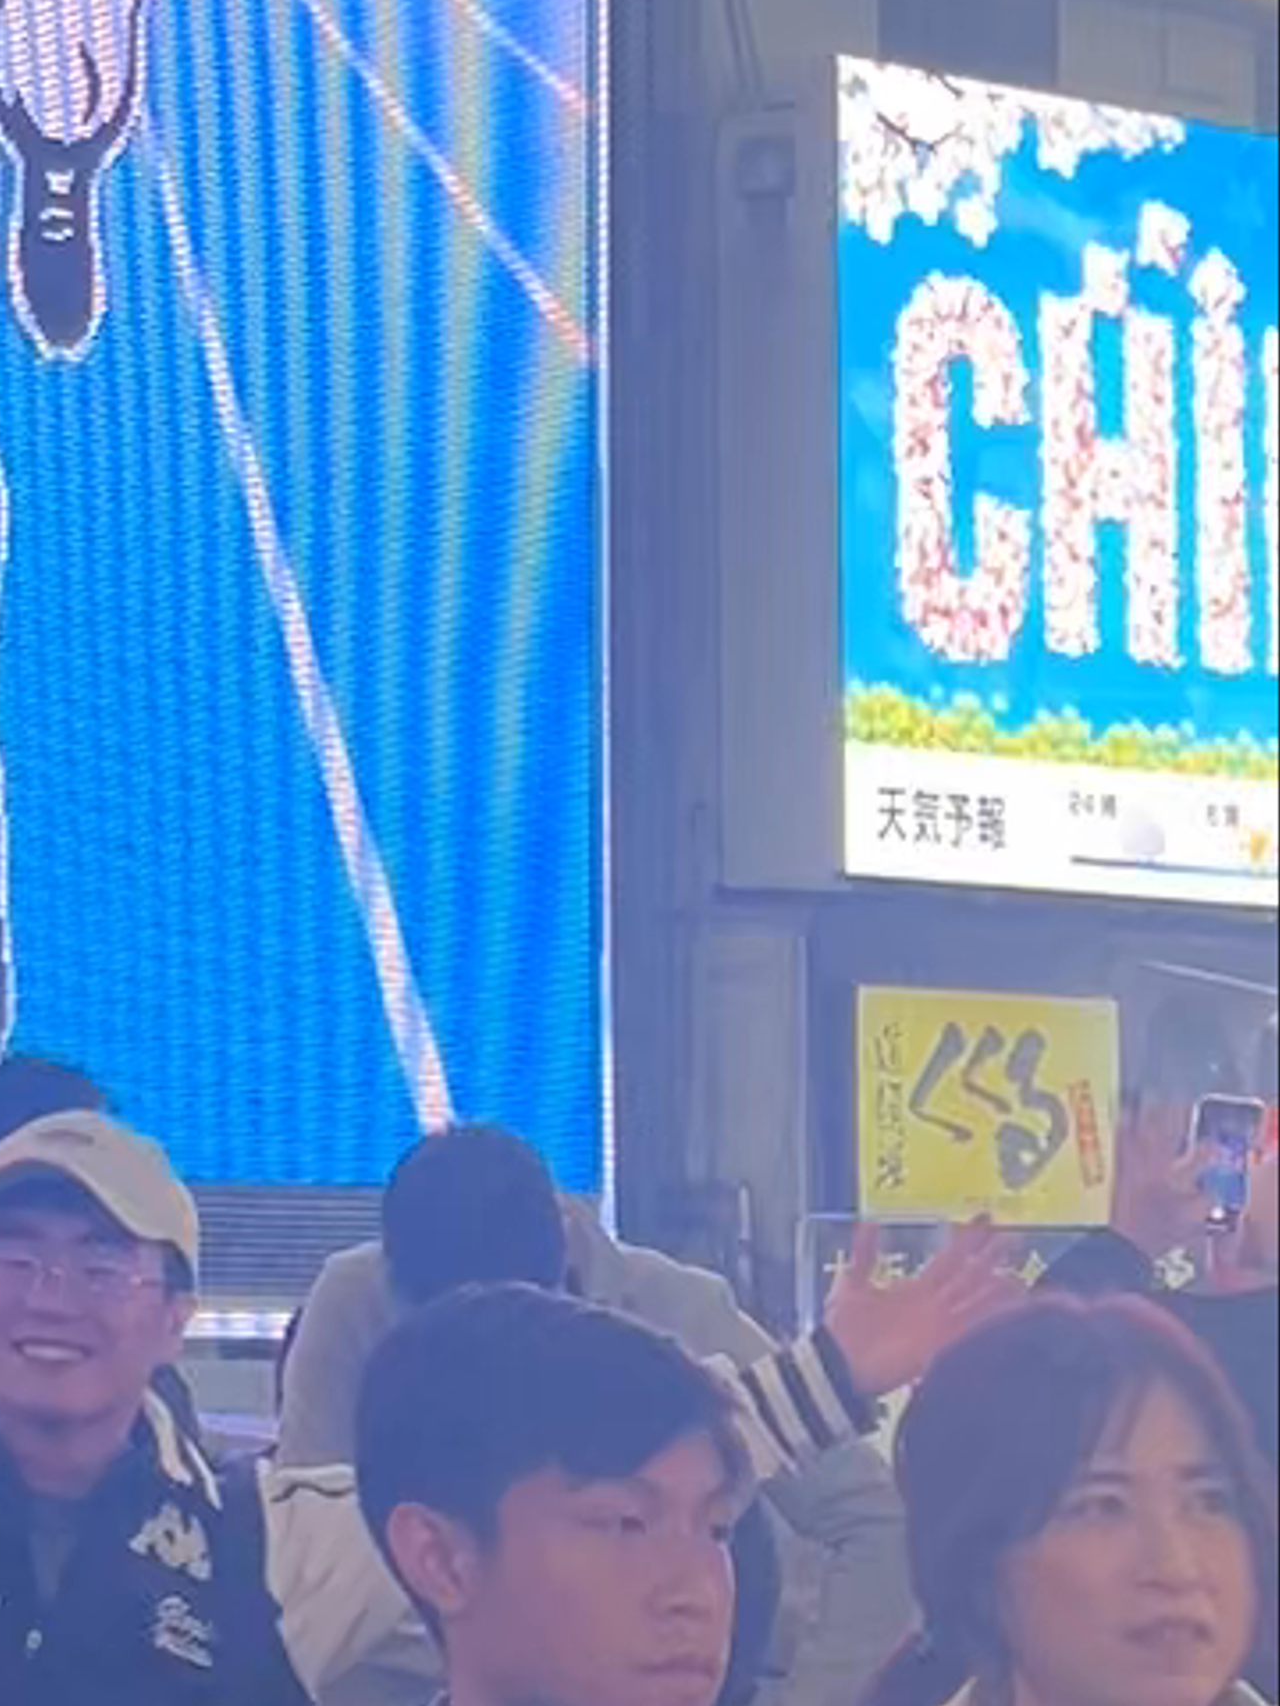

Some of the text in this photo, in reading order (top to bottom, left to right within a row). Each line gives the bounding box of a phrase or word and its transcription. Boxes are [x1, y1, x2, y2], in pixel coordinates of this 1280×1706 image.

[892, 246, 1279, 680] CHI
[907, 1019, 1069, 1192] くくる
